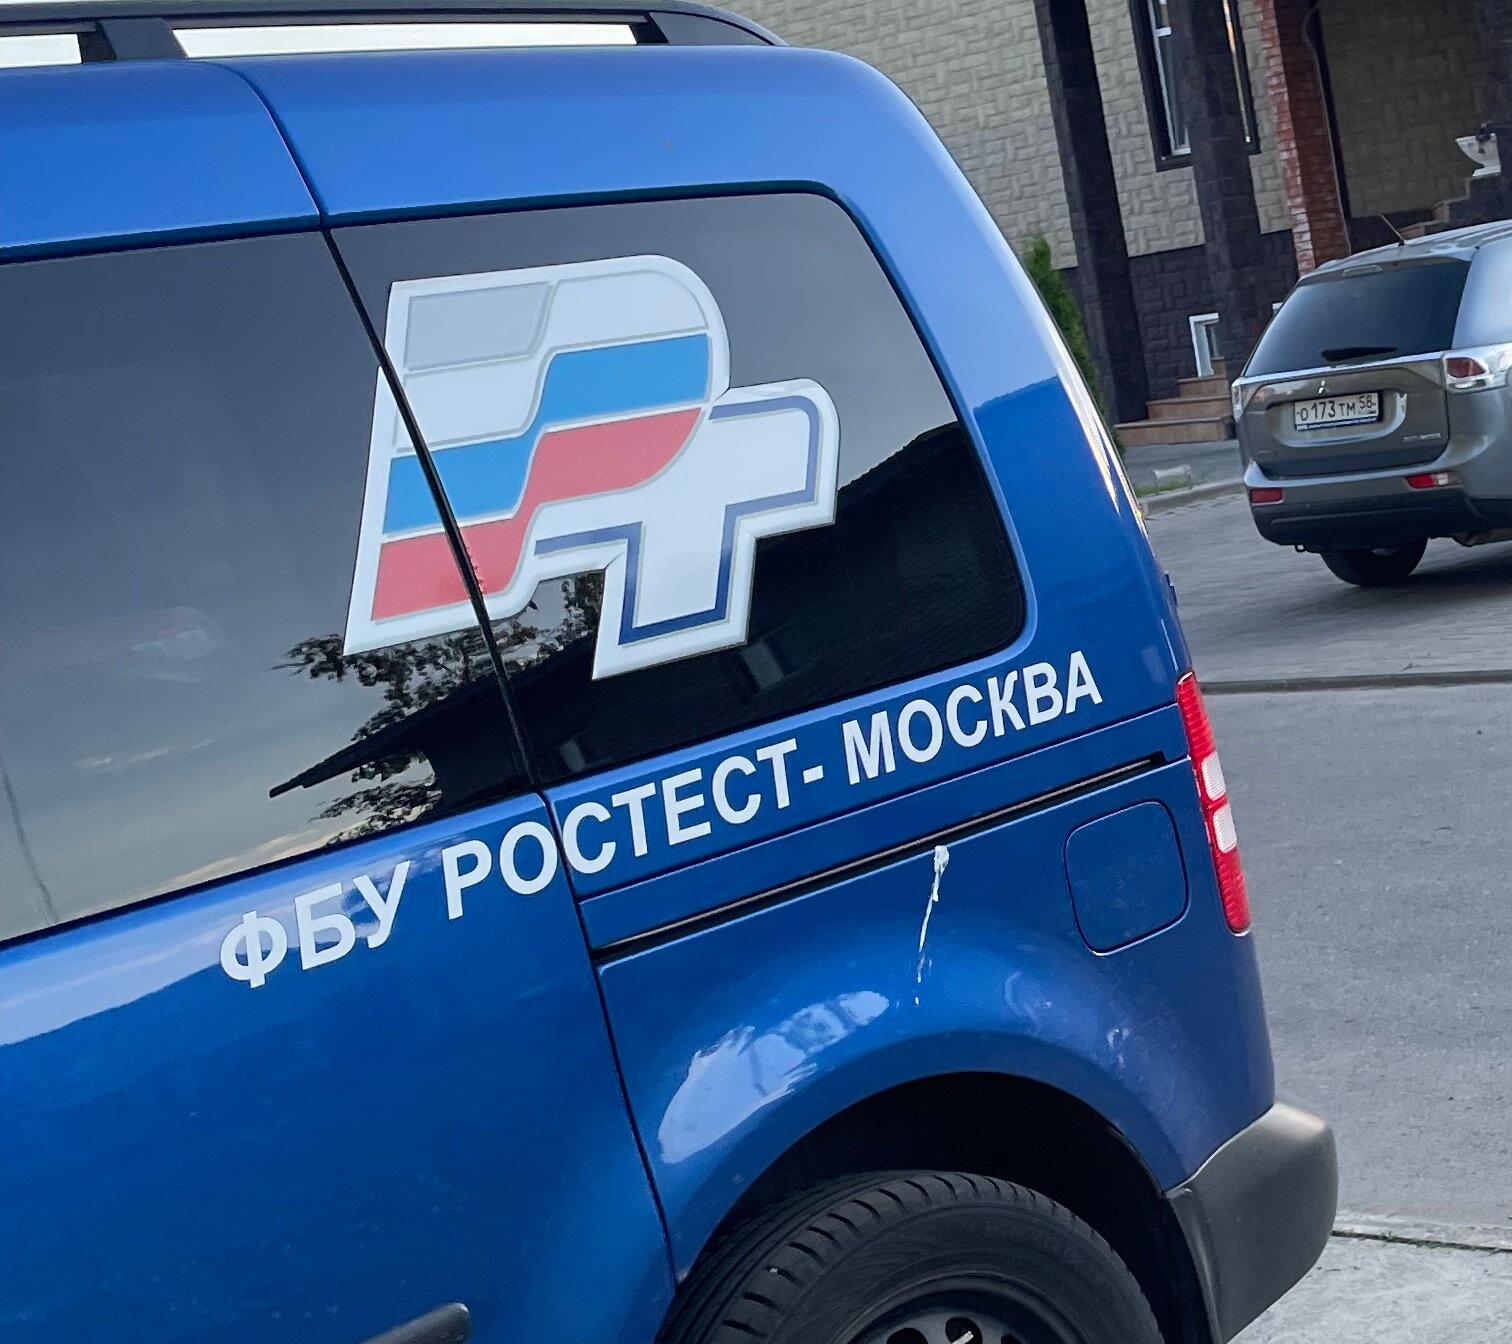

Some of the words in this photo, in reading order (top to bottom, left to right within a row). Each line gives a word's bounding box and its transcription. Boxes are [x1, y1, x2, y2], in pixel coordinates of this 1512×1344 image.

[220, 860, 411, 988] ФБУ
[441, 739, 825, 920] РОСТЕСТ-
[842, 651, 1103, 785] МОСКВА
